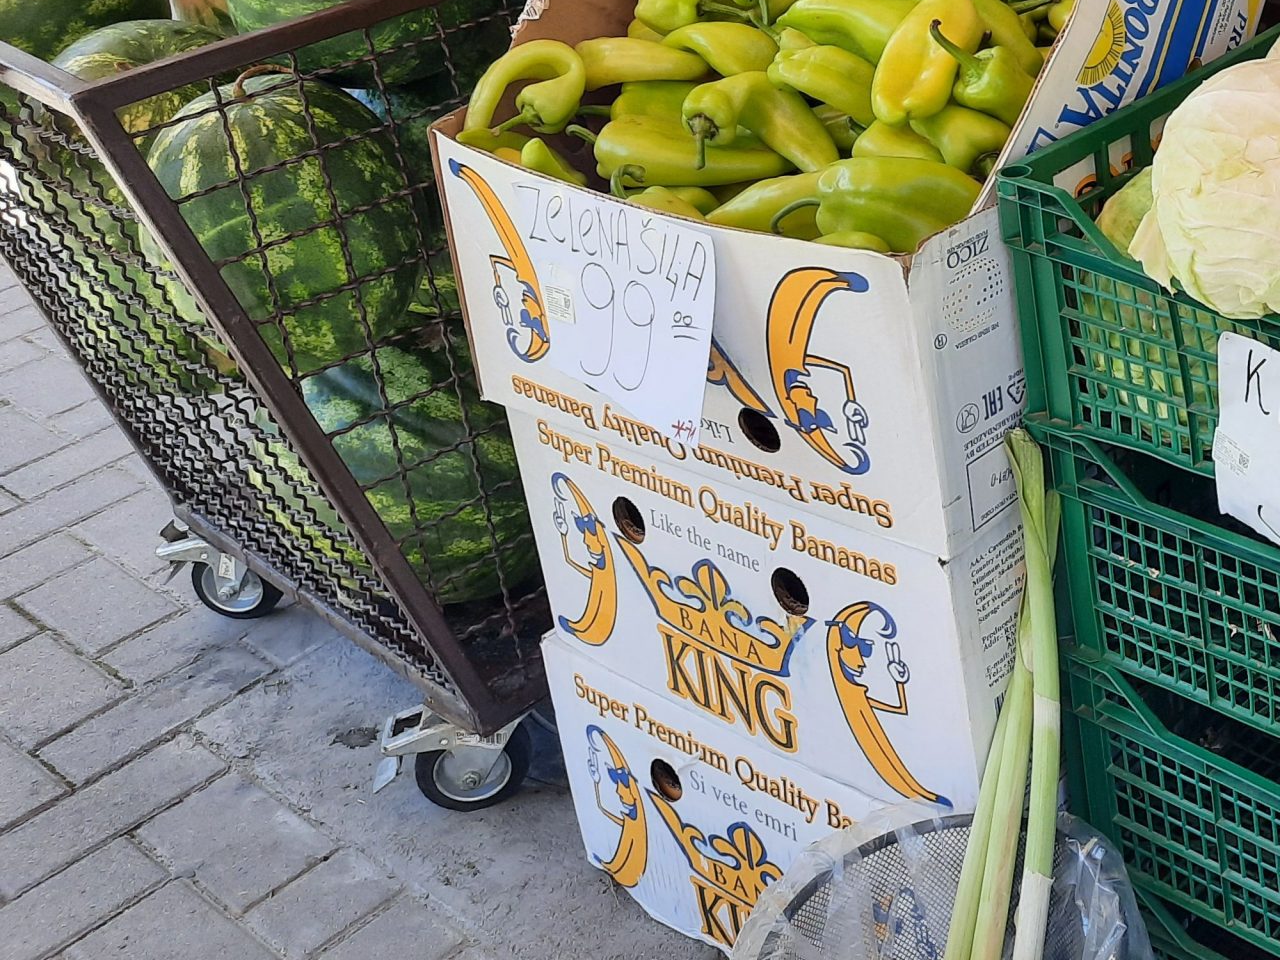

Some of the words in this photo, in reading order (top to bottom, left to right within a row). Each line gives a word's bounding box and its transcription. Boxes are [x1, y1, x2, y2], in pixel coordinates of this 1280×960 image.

[946, 234, 989, 269] ZICO
[511, 374, 598, 431] Bananas
[810, 480, 894, 530] Super
[537, 419, 592, 466] Super
[596, 443, 696, 509] Premium
[699, 486, 784, 551] Quality
[790, 521, 898, 585] Bananas
[650, 509, 682, 539] Like
[687, 527, 712, 550] the
[716, 543, 760, 572] name
[680, 607, 763, 665] BANA
[660, 626, 797, 751] KING
[574, 673, 629, 723] Super
[633, 702, 732, 775] Premium
[734, 756, 820, 823] Quality
[690, 770, 706, 796] Si
[712, 789, 748, 815] vete
[755, 807, 798, 841] emri
